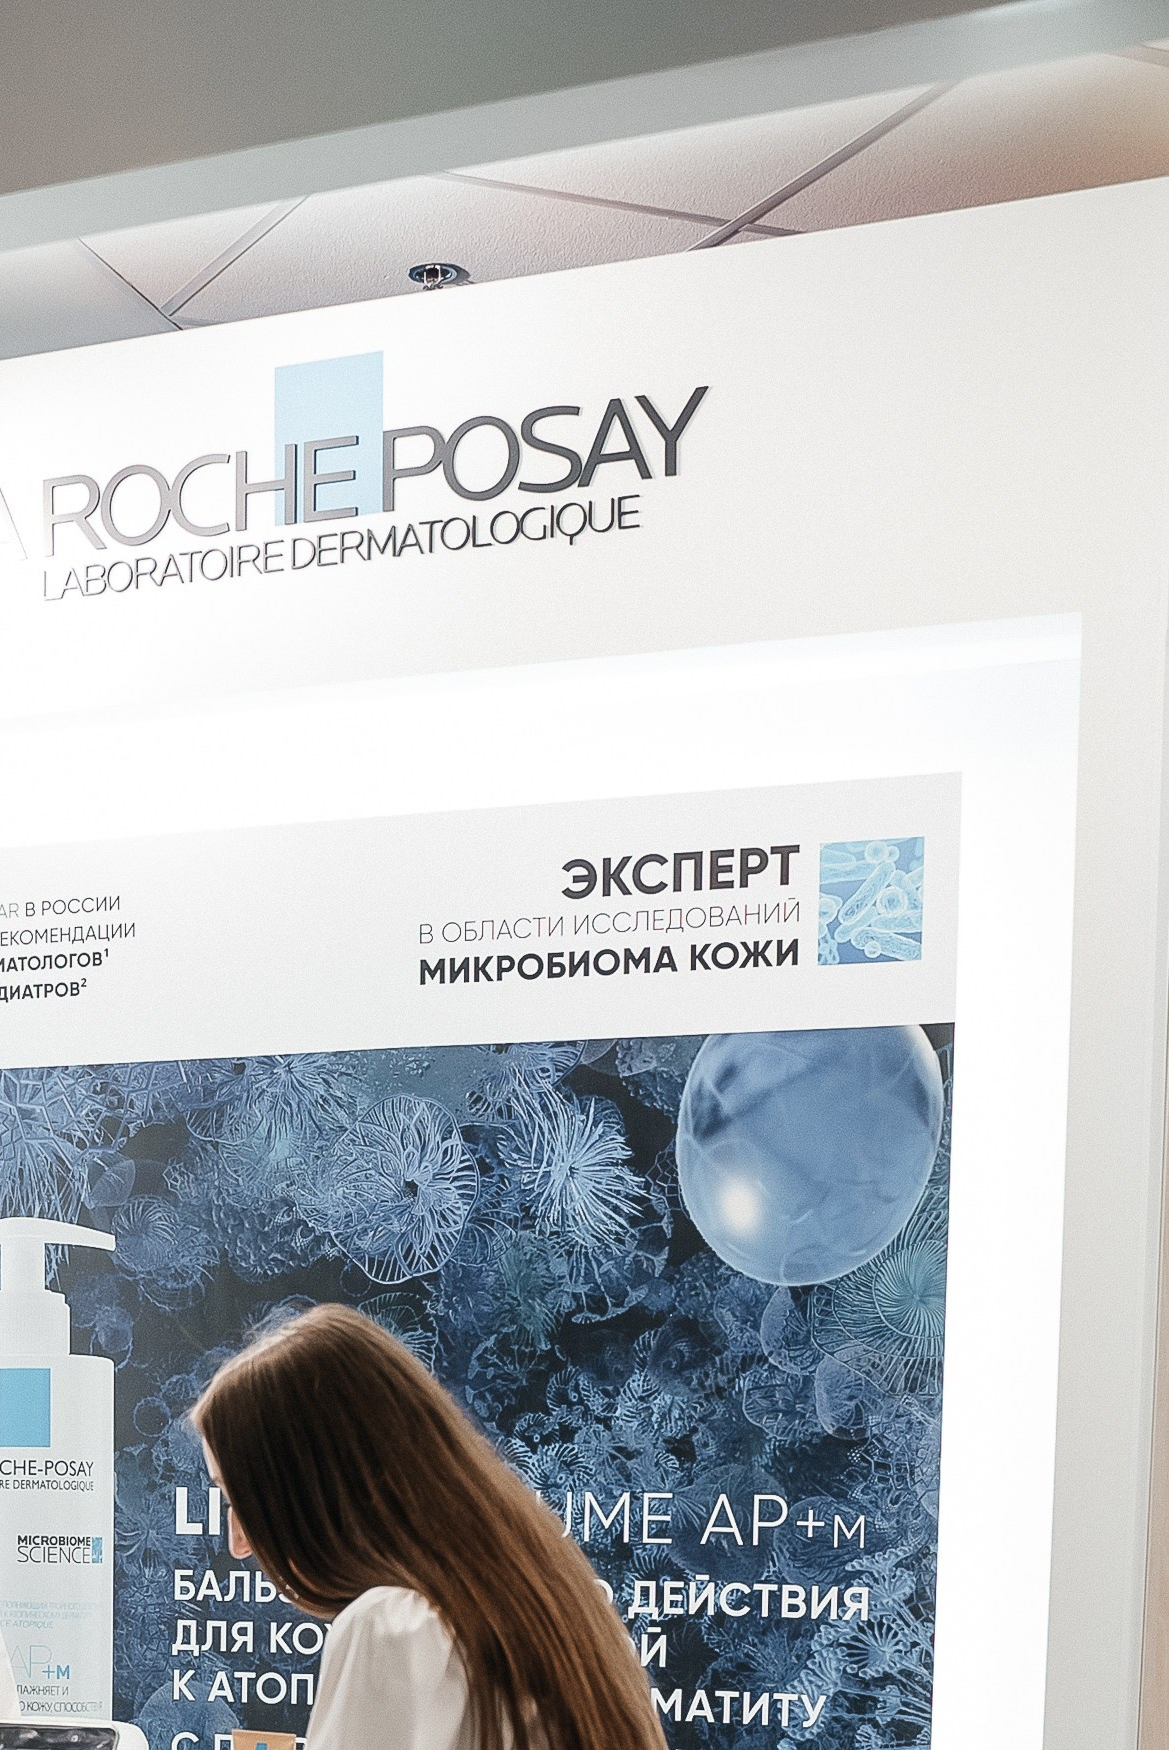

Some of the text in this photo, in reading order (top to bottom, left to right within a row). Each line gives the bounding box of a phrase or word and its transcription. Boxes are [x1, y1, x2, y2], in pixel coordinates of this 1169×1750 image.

[43, 434, 360, 558] ROCHE
[382, 385, 709, 512] POSAY
[43, 493, 644, 601] LABORATOIRE DERMATOLOGIQUE
[561, 844, 801, 900] ЭКСПЕРТ
[25, 901, 36, 918] В
[41, 895, 121, 916] РОССИИ
[419, 897, 801, 945] В ОБЛАСТИ ИССЛЕДОВАНИЙ
[419, 938, 800, 986] МИКРОБИОМА КОЖИ
[12, 1479, 94, 1492] DERMATOLOGIQUE
[17, 1534, 91, 1547] MICROBIOME
[17, 1546, 91, 1564] SCIENCE
[173, 1569, 292, 1604] БАЛЬ
[628, 1574, 870, 1621] ДЕЙСТВИЯ
[171, 1619, 254, 1657] ДЛЯ
[62, 1686, 69, 1696] И
[173, 1669, 197, 1701] К
[651, 1687, 828, 1730] МАТИТУ
